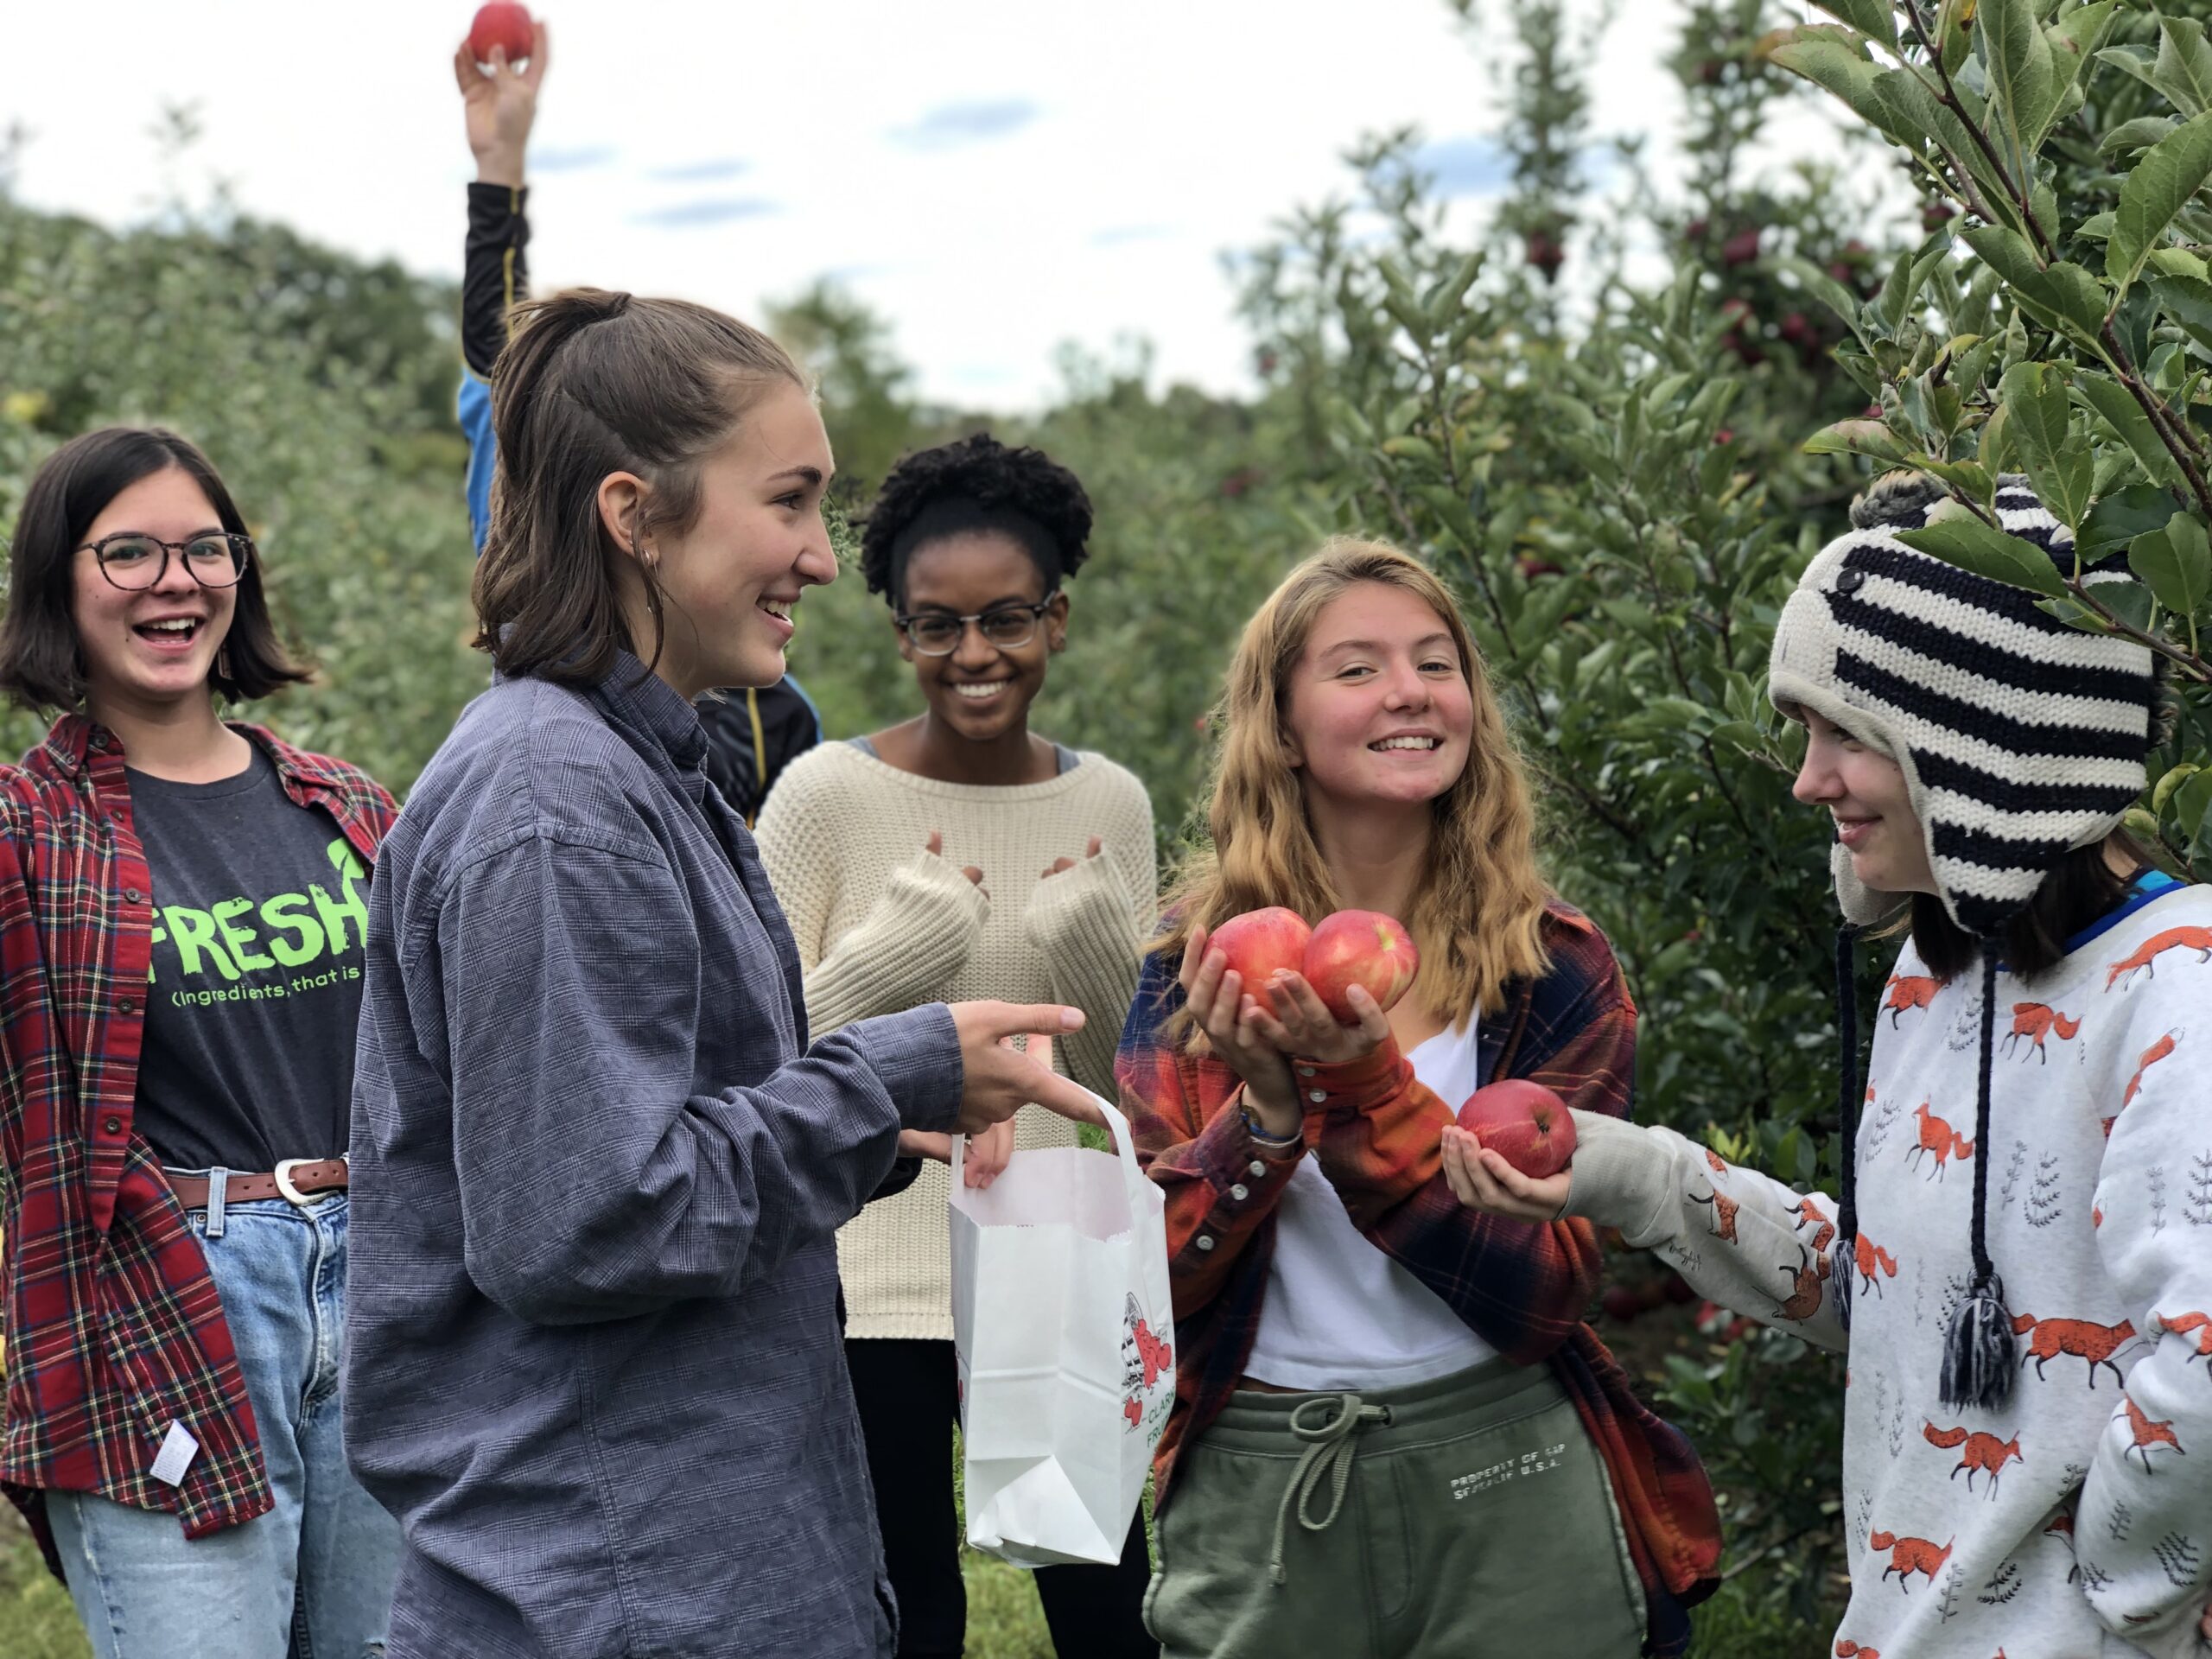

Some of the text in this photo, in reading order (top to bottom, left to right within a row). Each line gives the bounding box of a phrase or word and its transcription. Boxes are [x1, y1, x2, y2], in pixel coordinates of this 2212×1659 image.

[172, 965, 361, 1007] (Ingredients, that is
[1450, 1459, 1515, 1488] PROPERTY
[1521, 1451, 1539, 1464] OF
